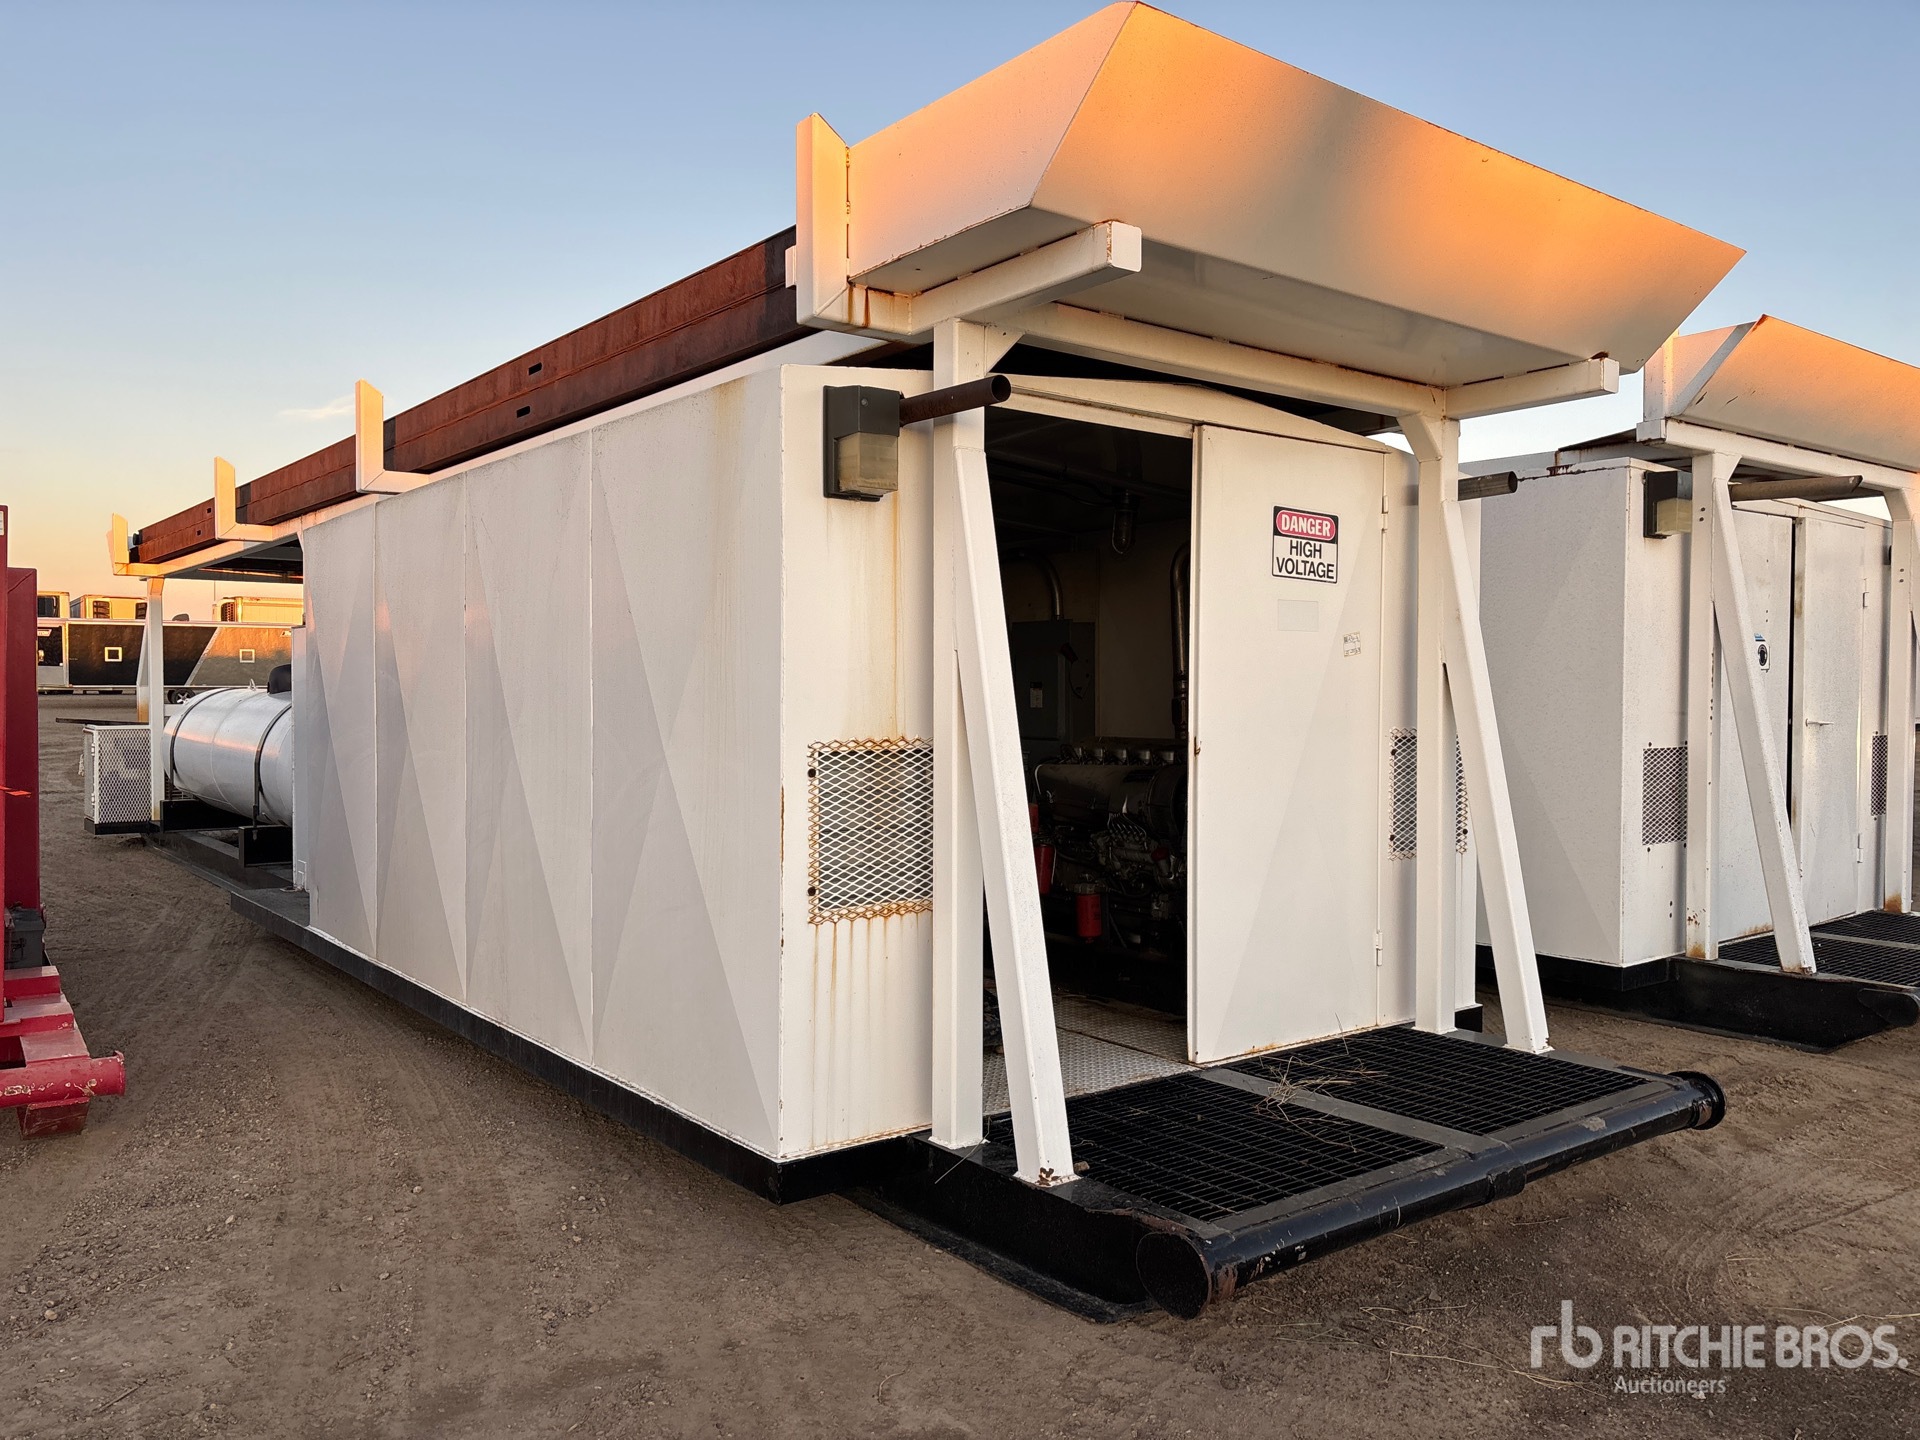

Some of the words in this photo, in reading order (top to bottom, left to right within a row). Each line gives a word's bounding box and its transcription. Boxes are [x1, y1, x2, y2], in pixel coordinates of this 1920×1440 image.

[1281, 514, 1331, 537] DANGER
[1290, 540, 1322, 559] HIGH
[1276, 557, 1334, 579] VOLTAGE
